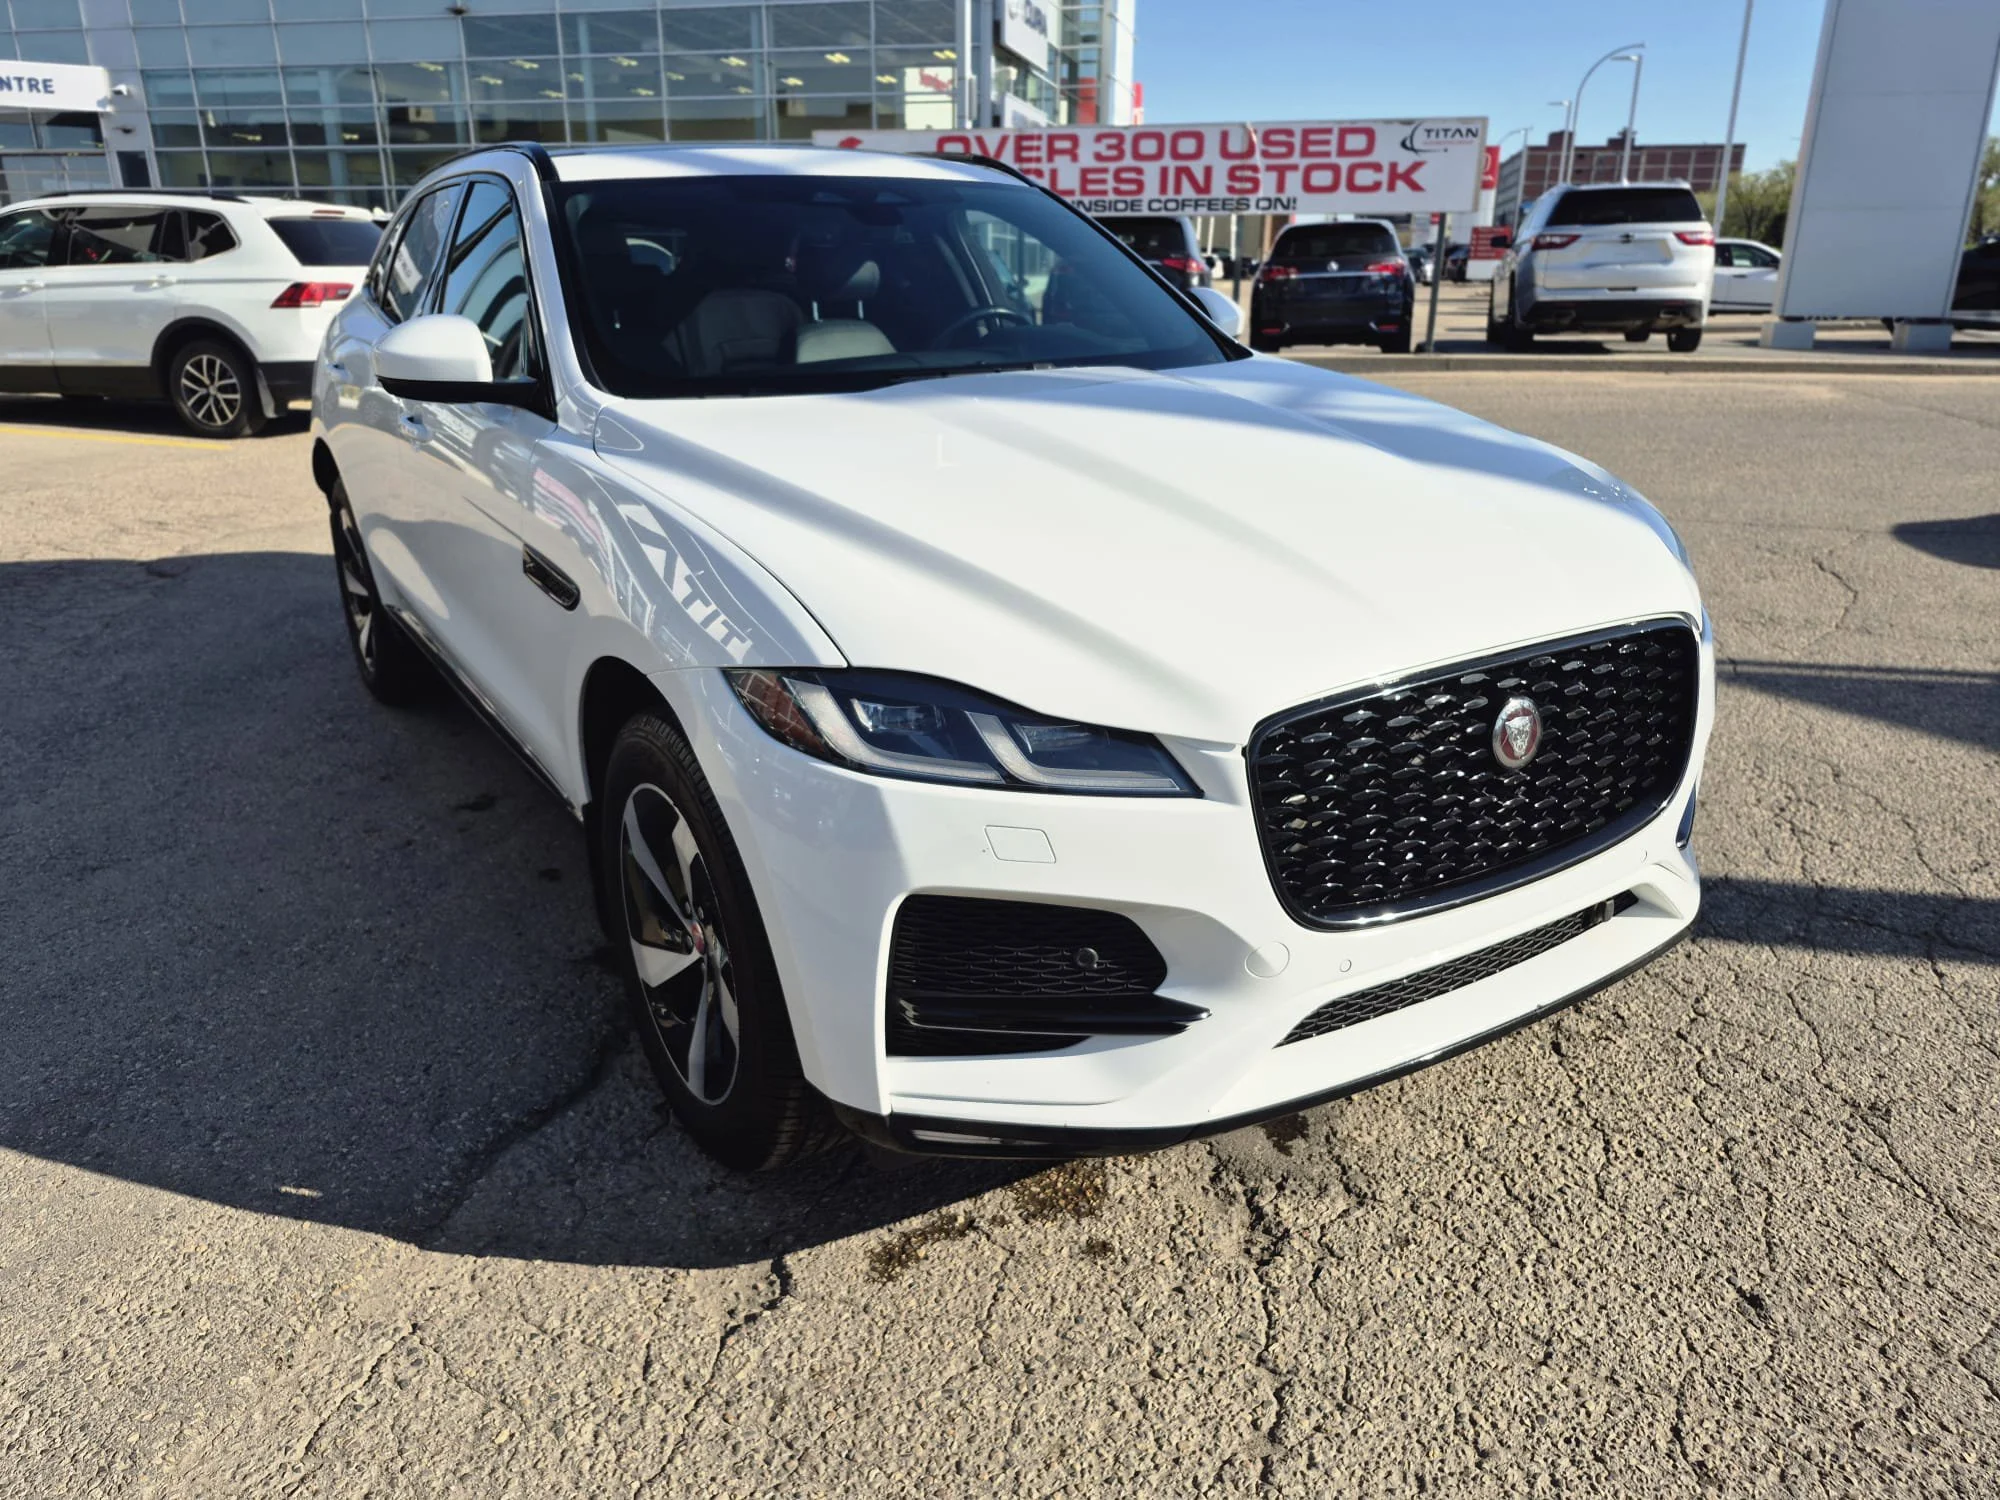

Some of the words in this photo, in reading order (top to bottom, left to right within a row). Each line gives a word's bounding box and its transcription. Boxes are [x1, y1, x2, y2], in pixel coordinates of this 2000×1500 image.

[936, 133, 1079, 163] OVER
[1094, 130, 1205, 162] 300
[1219, 127, 1376, 161] USED
[1424, 127, 1479, 139] TITAN
[1159, 165, 1212, 196] IN
[1226, 160, 1427, 195] STOCK
[1147, 198, 1250, 212] COFFEES
[1255, 196, 1297, 212] ON!
